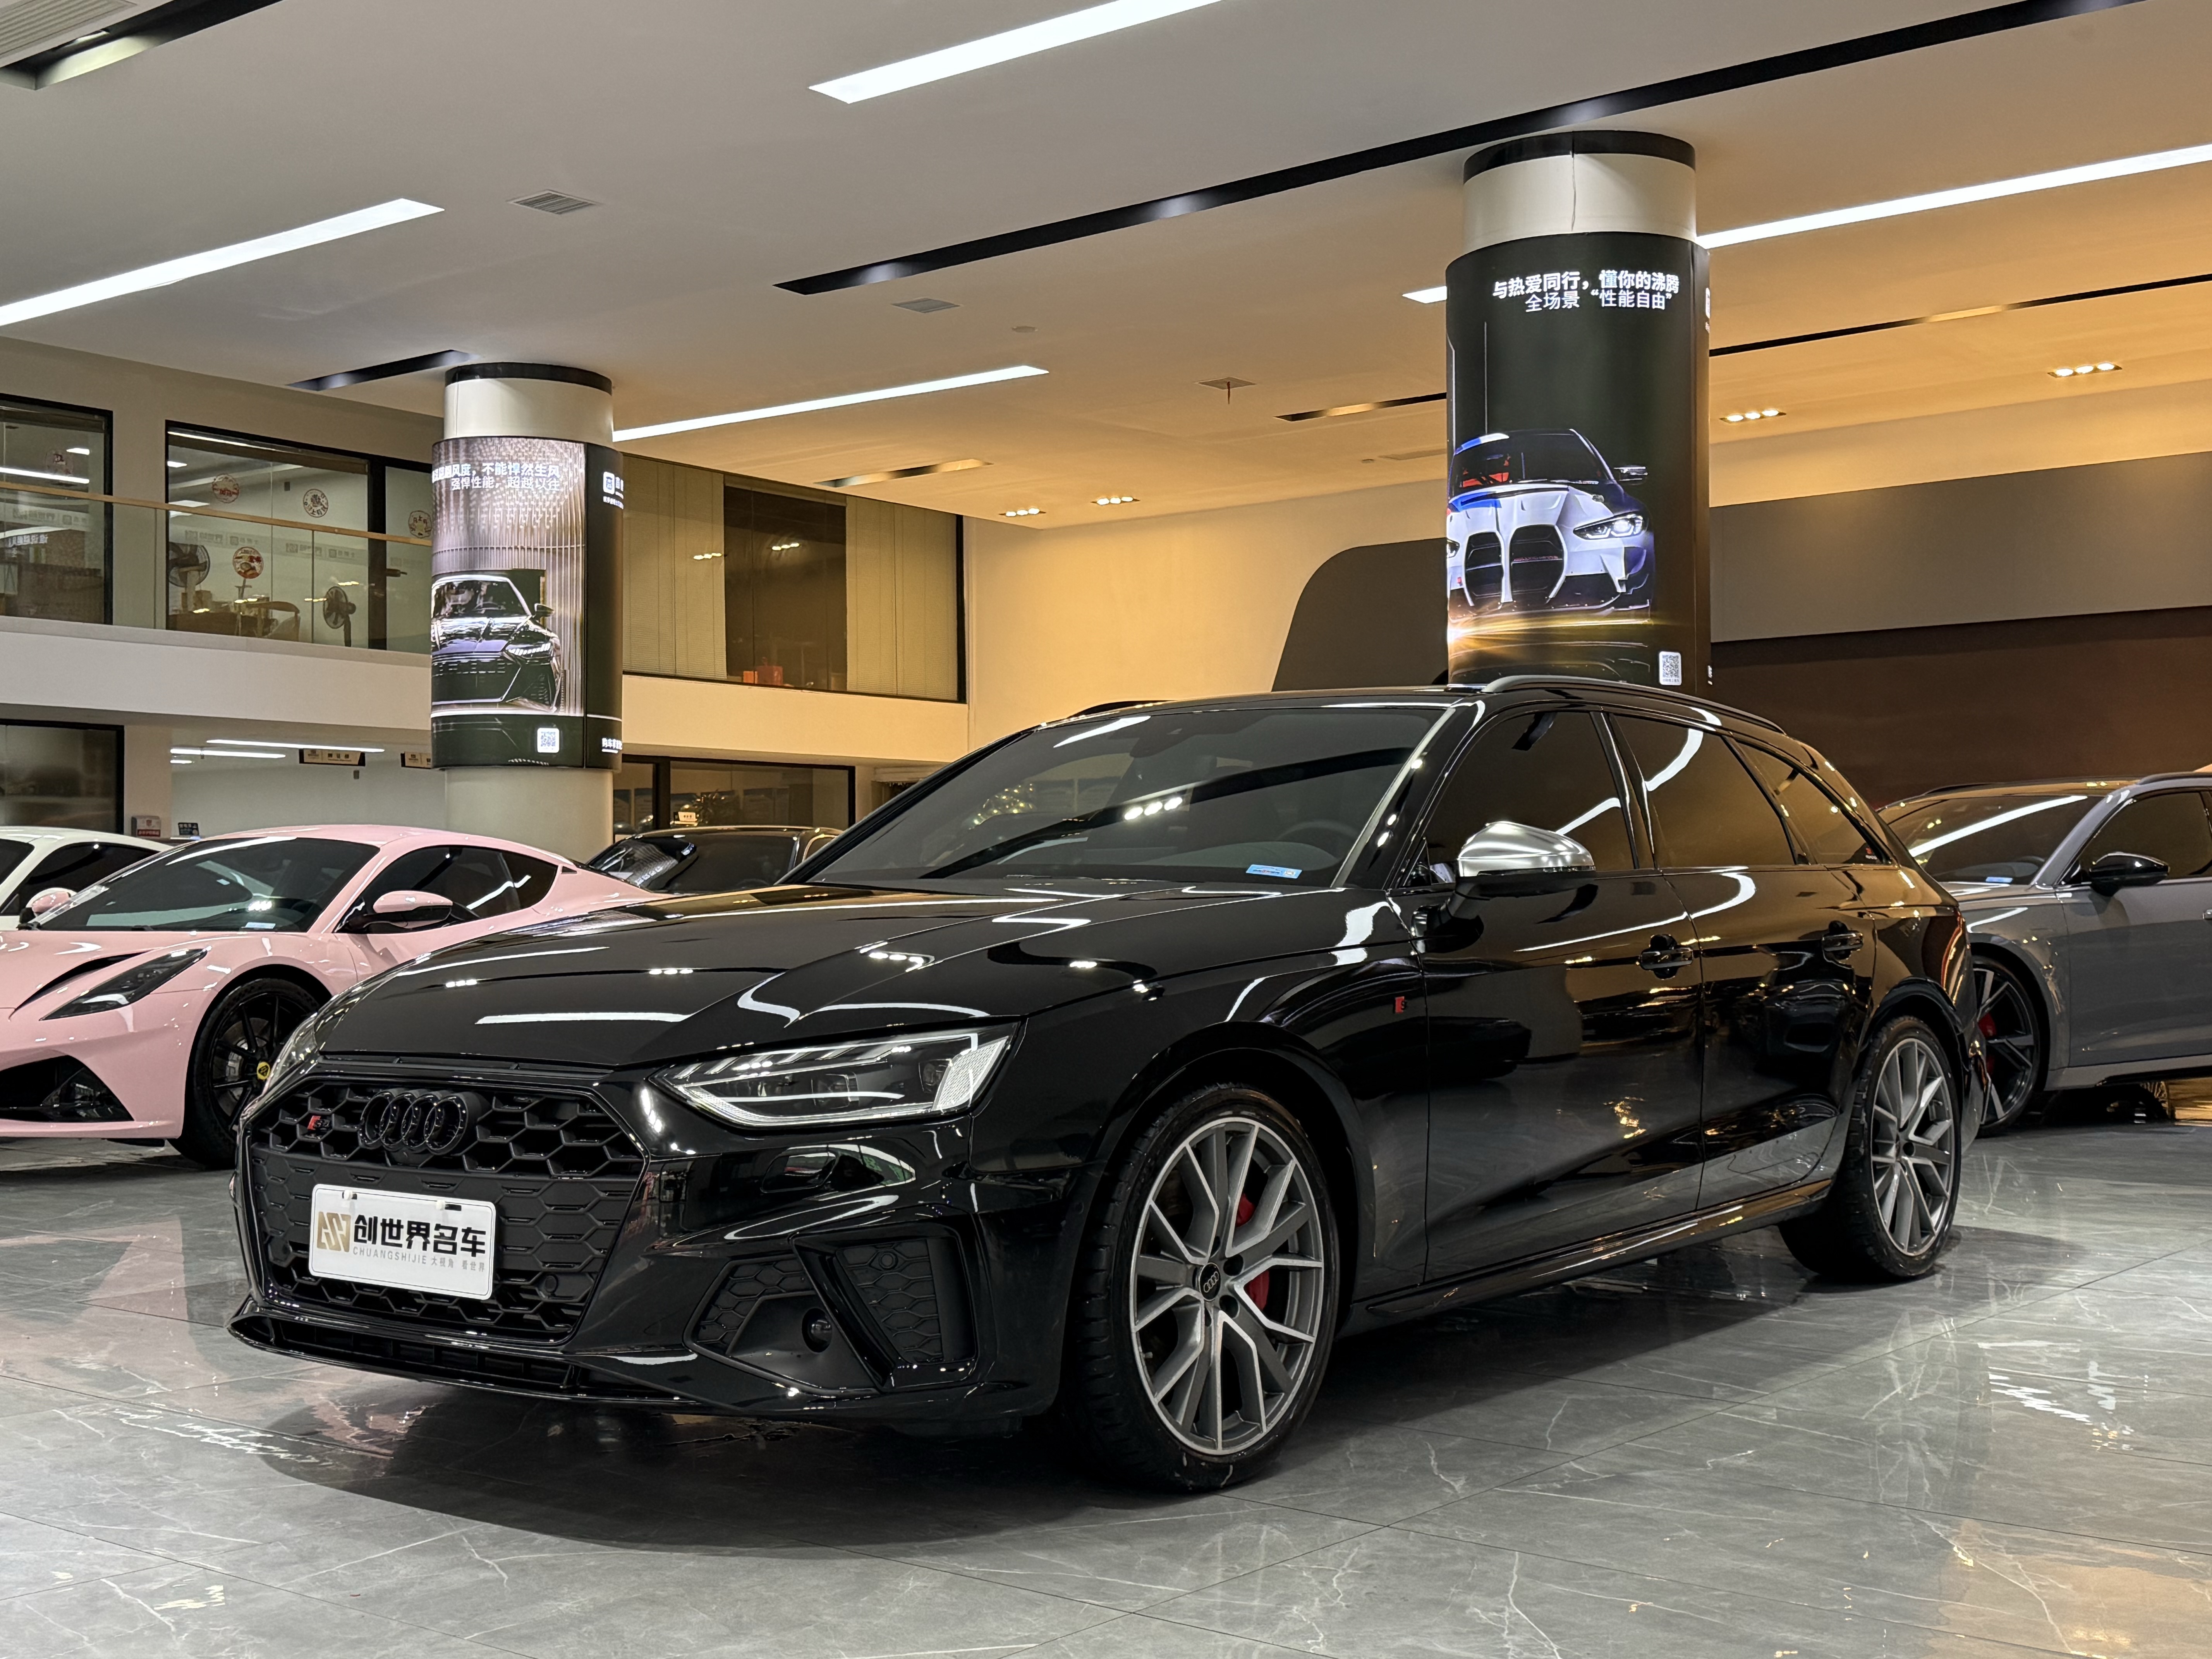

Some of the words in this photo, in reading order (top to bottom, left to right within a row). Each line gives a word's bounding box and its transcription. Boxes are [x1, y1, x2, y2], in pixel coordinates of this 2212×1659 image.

[354, 1215, 486, 1257] 创世界名车
[353, 1247, 426, 1264] CHUANGSHIJIE
[431, 1257, 453, 1268] 大视角
[462, 1260, 484, 1272] 看世界
